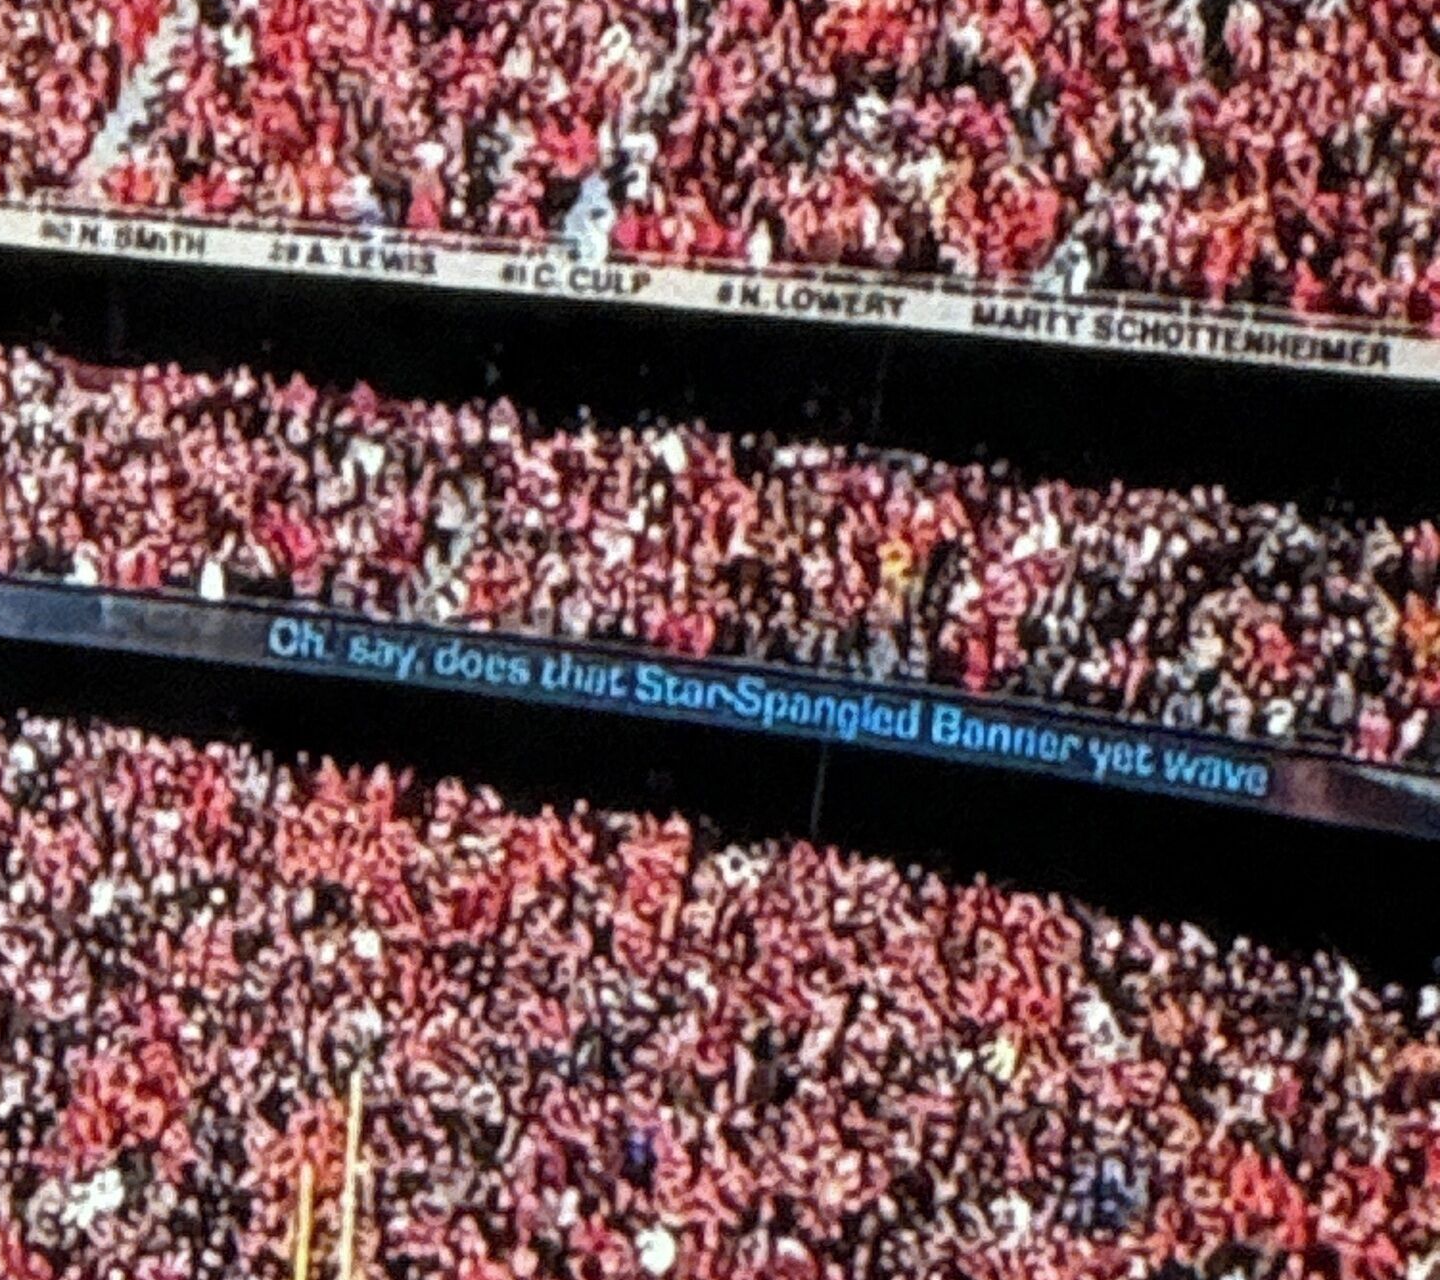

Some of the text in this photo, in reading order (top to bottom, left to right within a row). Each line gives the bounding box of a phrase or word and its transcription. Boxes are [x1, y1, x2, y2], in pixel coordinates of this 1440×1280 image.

[570, 266, 652, 297] CULP
[972, 300, 1391, 370] MARTY SCHOTTENHEIMER
[433, 639, 531, 688] does
[540, 654, 628, 698] that
[932, 704, 1086, 763] Banner
[1088, 735, 1157, 783] yet
[1164, 746, 1269, 797] wave
